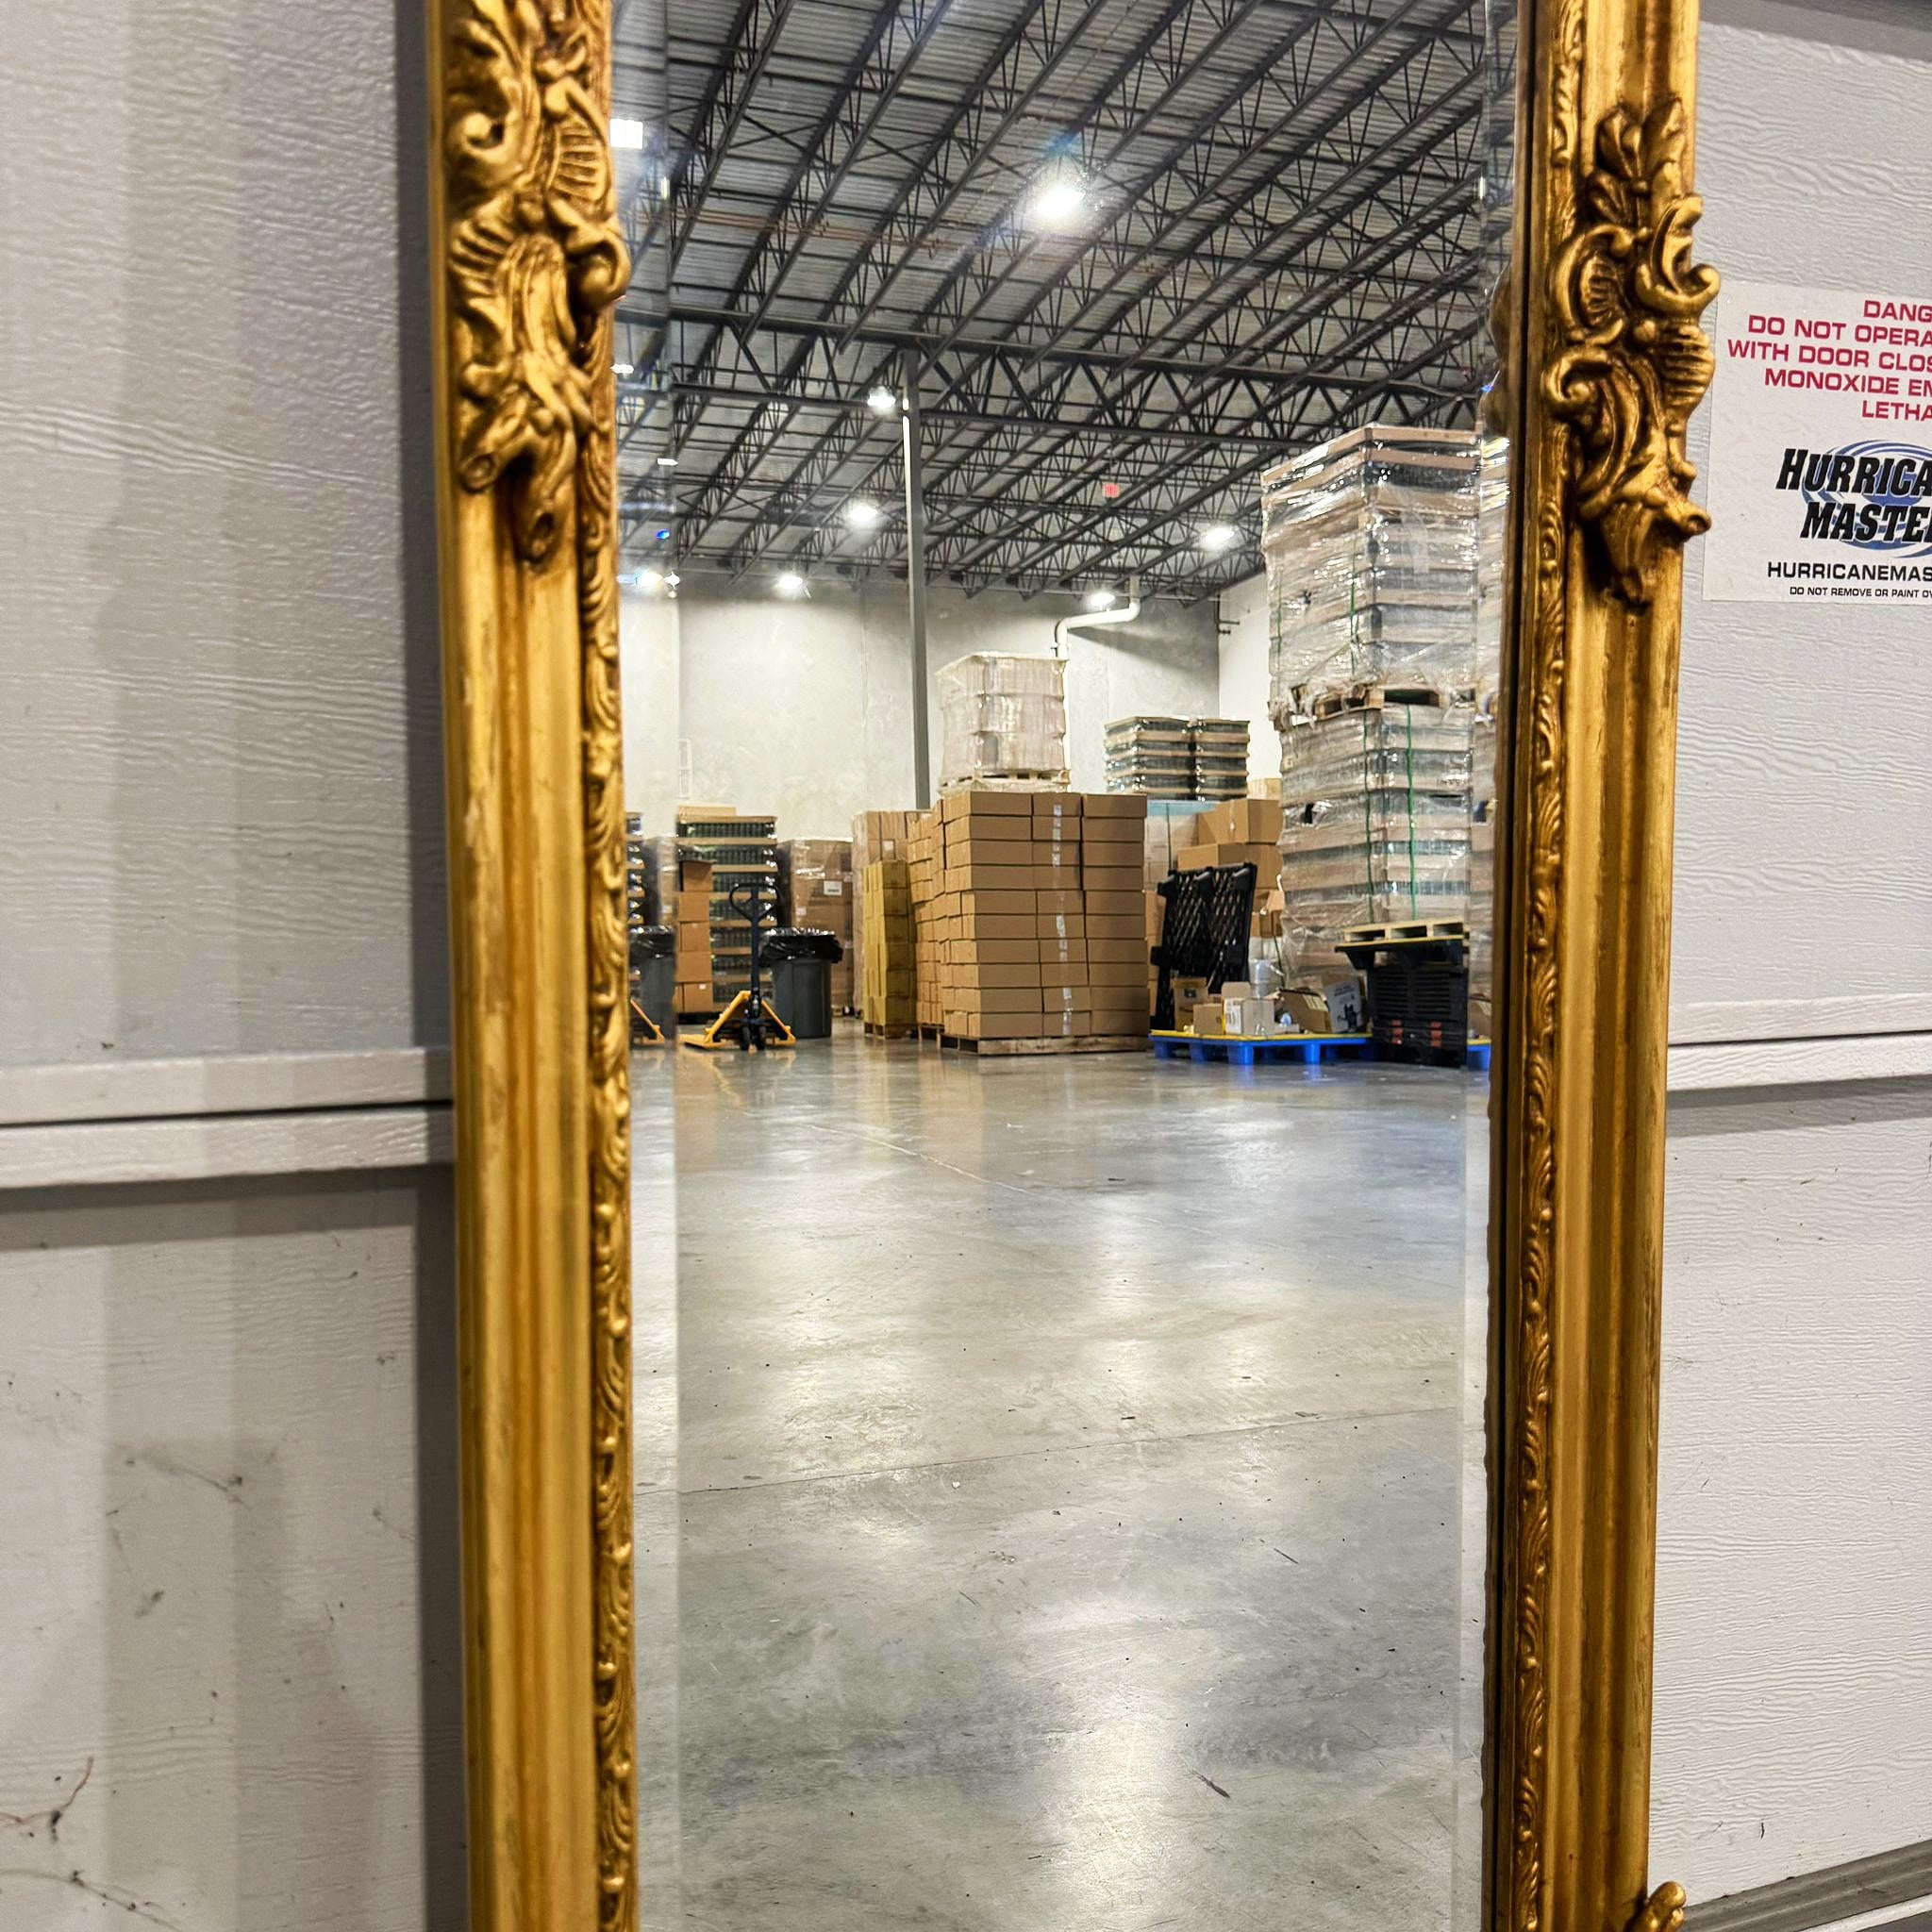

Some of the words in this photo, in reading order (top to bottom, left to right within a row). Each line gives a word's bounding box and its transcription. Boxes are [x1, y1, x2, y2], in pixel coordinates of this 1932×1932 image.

[1863, 300, 1932, 323] DANG
[1748, 315, 1785, 336] DO
[1794, 319, 1847, 341] NOT
[1855, 325, 1932, 347] OPERA
[1727, 340, 1790, 362] WITH
[1798, 345, 1869, 368] DOOR
[1764, 368, 1900, 394] MONOXIDE
[1861, 400, 1932, 422] LETHA
[1775, 448, 1932, 497] HURRICA
[1767, 561, 1932, 582] HURRICANEMAS
[1790, 587, 1805, 595] DO
[1807, 587, 1828, 596] NOT
[1831, 587, 1873, 597] REMOVE
[1874, 589, 1889, 597] OR
[1891, 589, 1920, 598] PAINT
